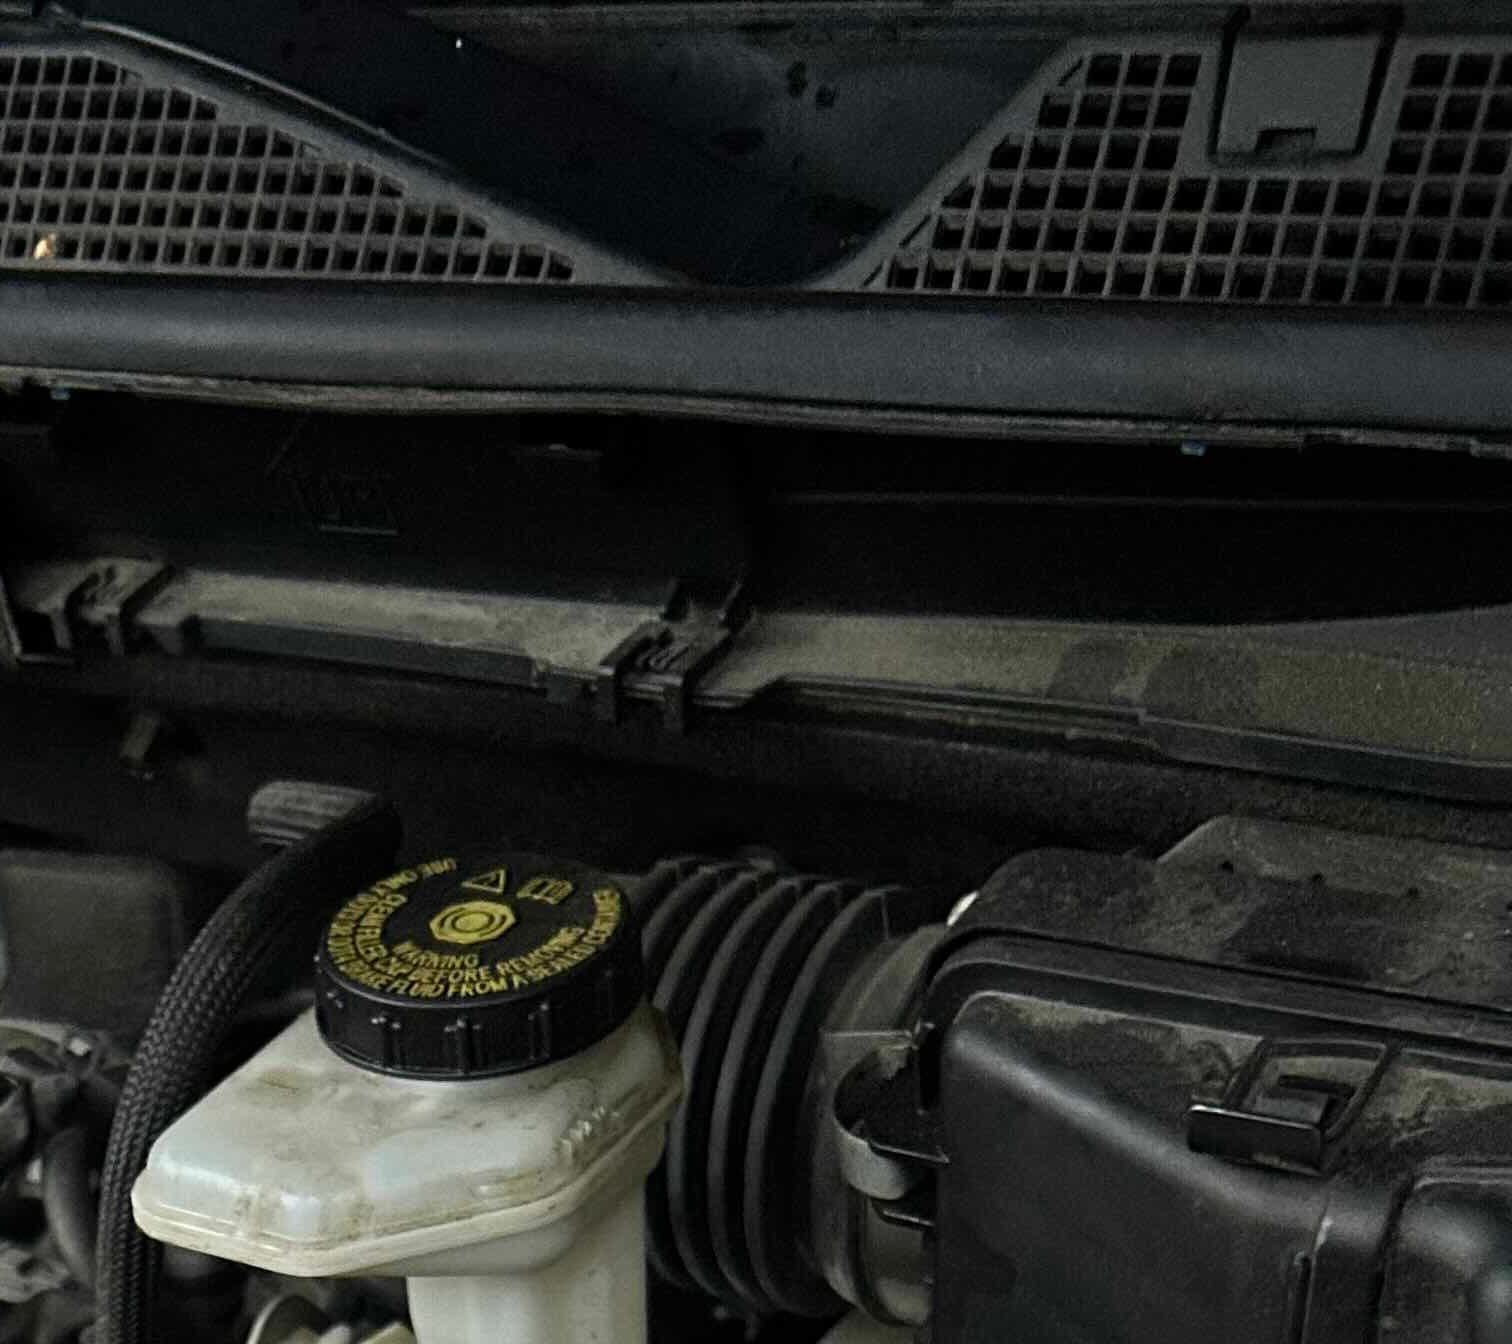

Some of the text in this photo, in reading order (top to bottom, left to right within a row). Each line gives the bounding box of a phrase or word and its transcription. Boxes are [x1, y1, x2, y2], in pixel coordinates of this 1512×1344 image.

[390, 942, 479, 969] WARNING
[408, 965, 491, 985] BEFORE
[496, 927, 586, 977] REMOVING
[447, 976, 509, 998] FROM
